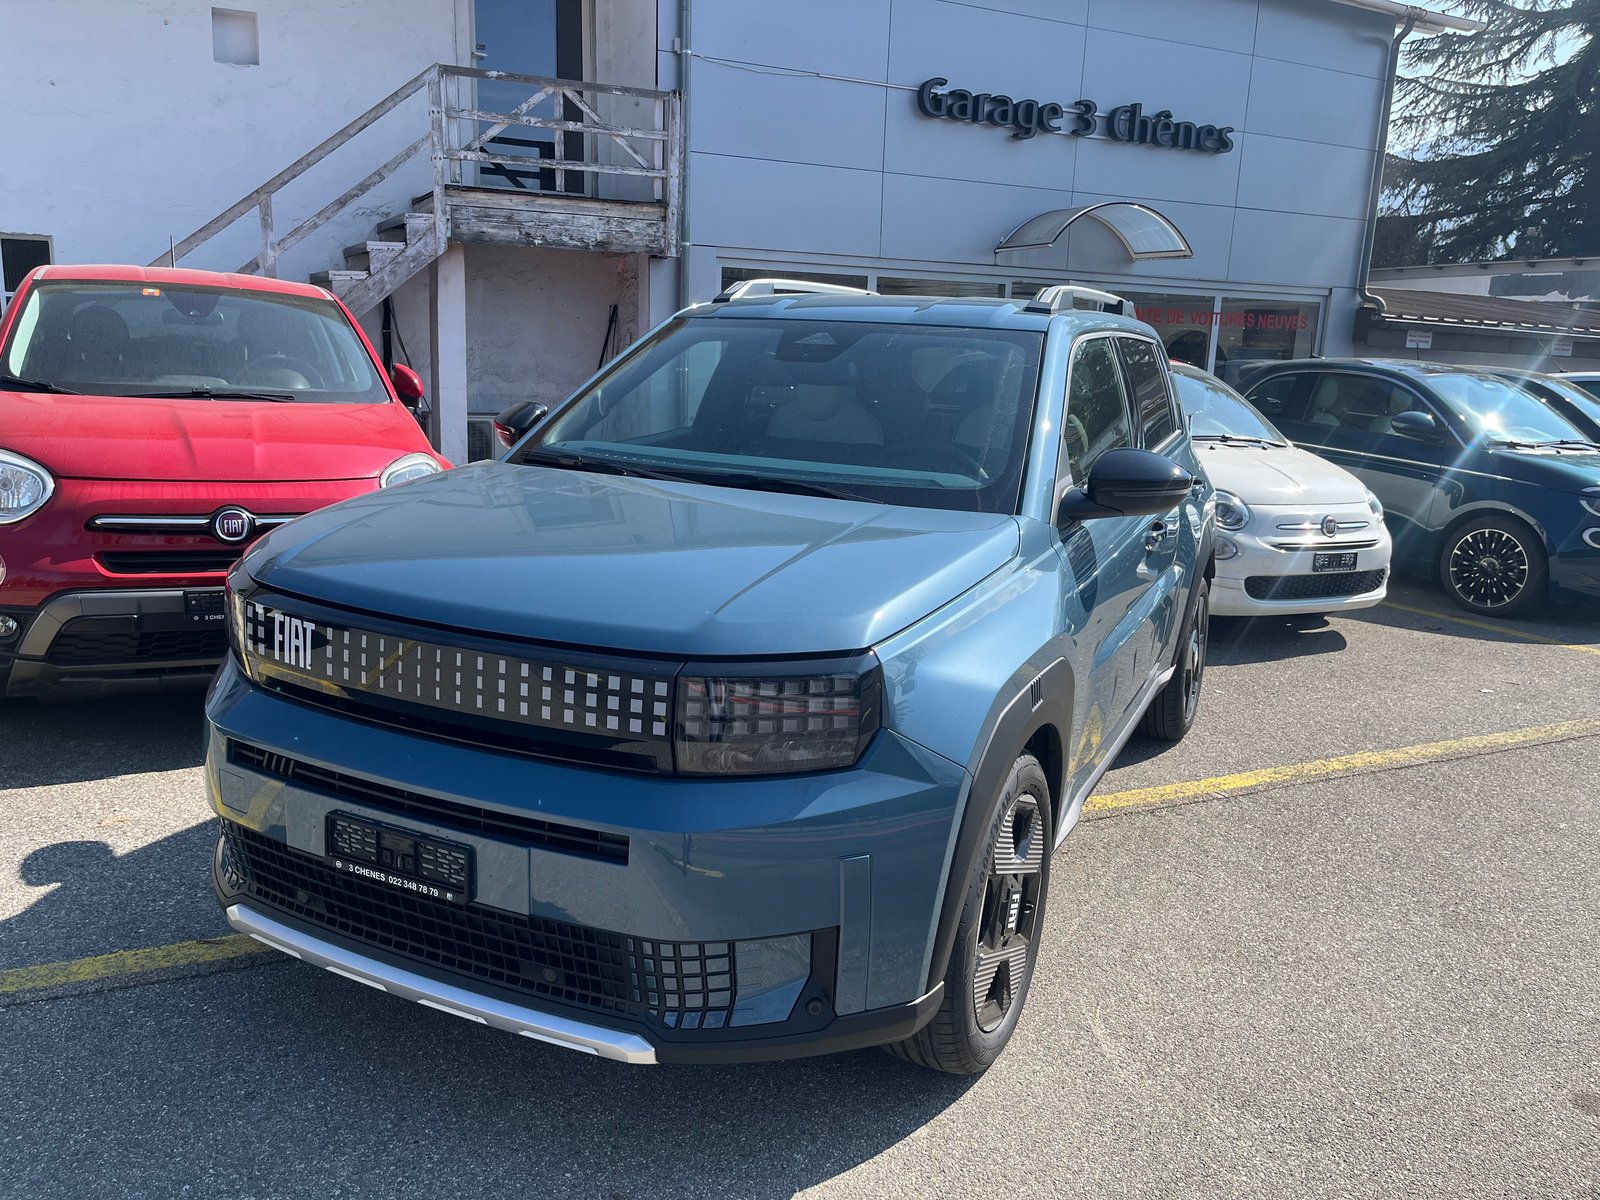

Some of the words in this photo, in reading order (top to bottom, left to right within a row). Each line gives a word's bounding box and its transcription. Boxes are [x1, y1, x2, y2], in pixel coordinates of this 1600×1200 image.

[917, 77, 1064, 140] Garage
[1071, 99, 1098, 137] 3
[1107, 103, 1235, 153] Chênes
[1136, 308, 1162, 323] NTE
[1166, 309, 1185, 324] DE
[1191, 311, 1254, 328] VOITURES
[1258, 312, 1308, 330] NEUVES
[223, 519, 243, 534] FIAT
[274, 613, 316, 671] FIAT
[348, 864, 354, 872] 3
[354, 865, 386, 882] CHENES
[388, 875, 402, 886] 022
[403, 879, 417, 891] 348
[418, 884, 428, 894] 78
[429, 887, 439, 897] 79
[1007, 893, 1020, 931] FIAT
